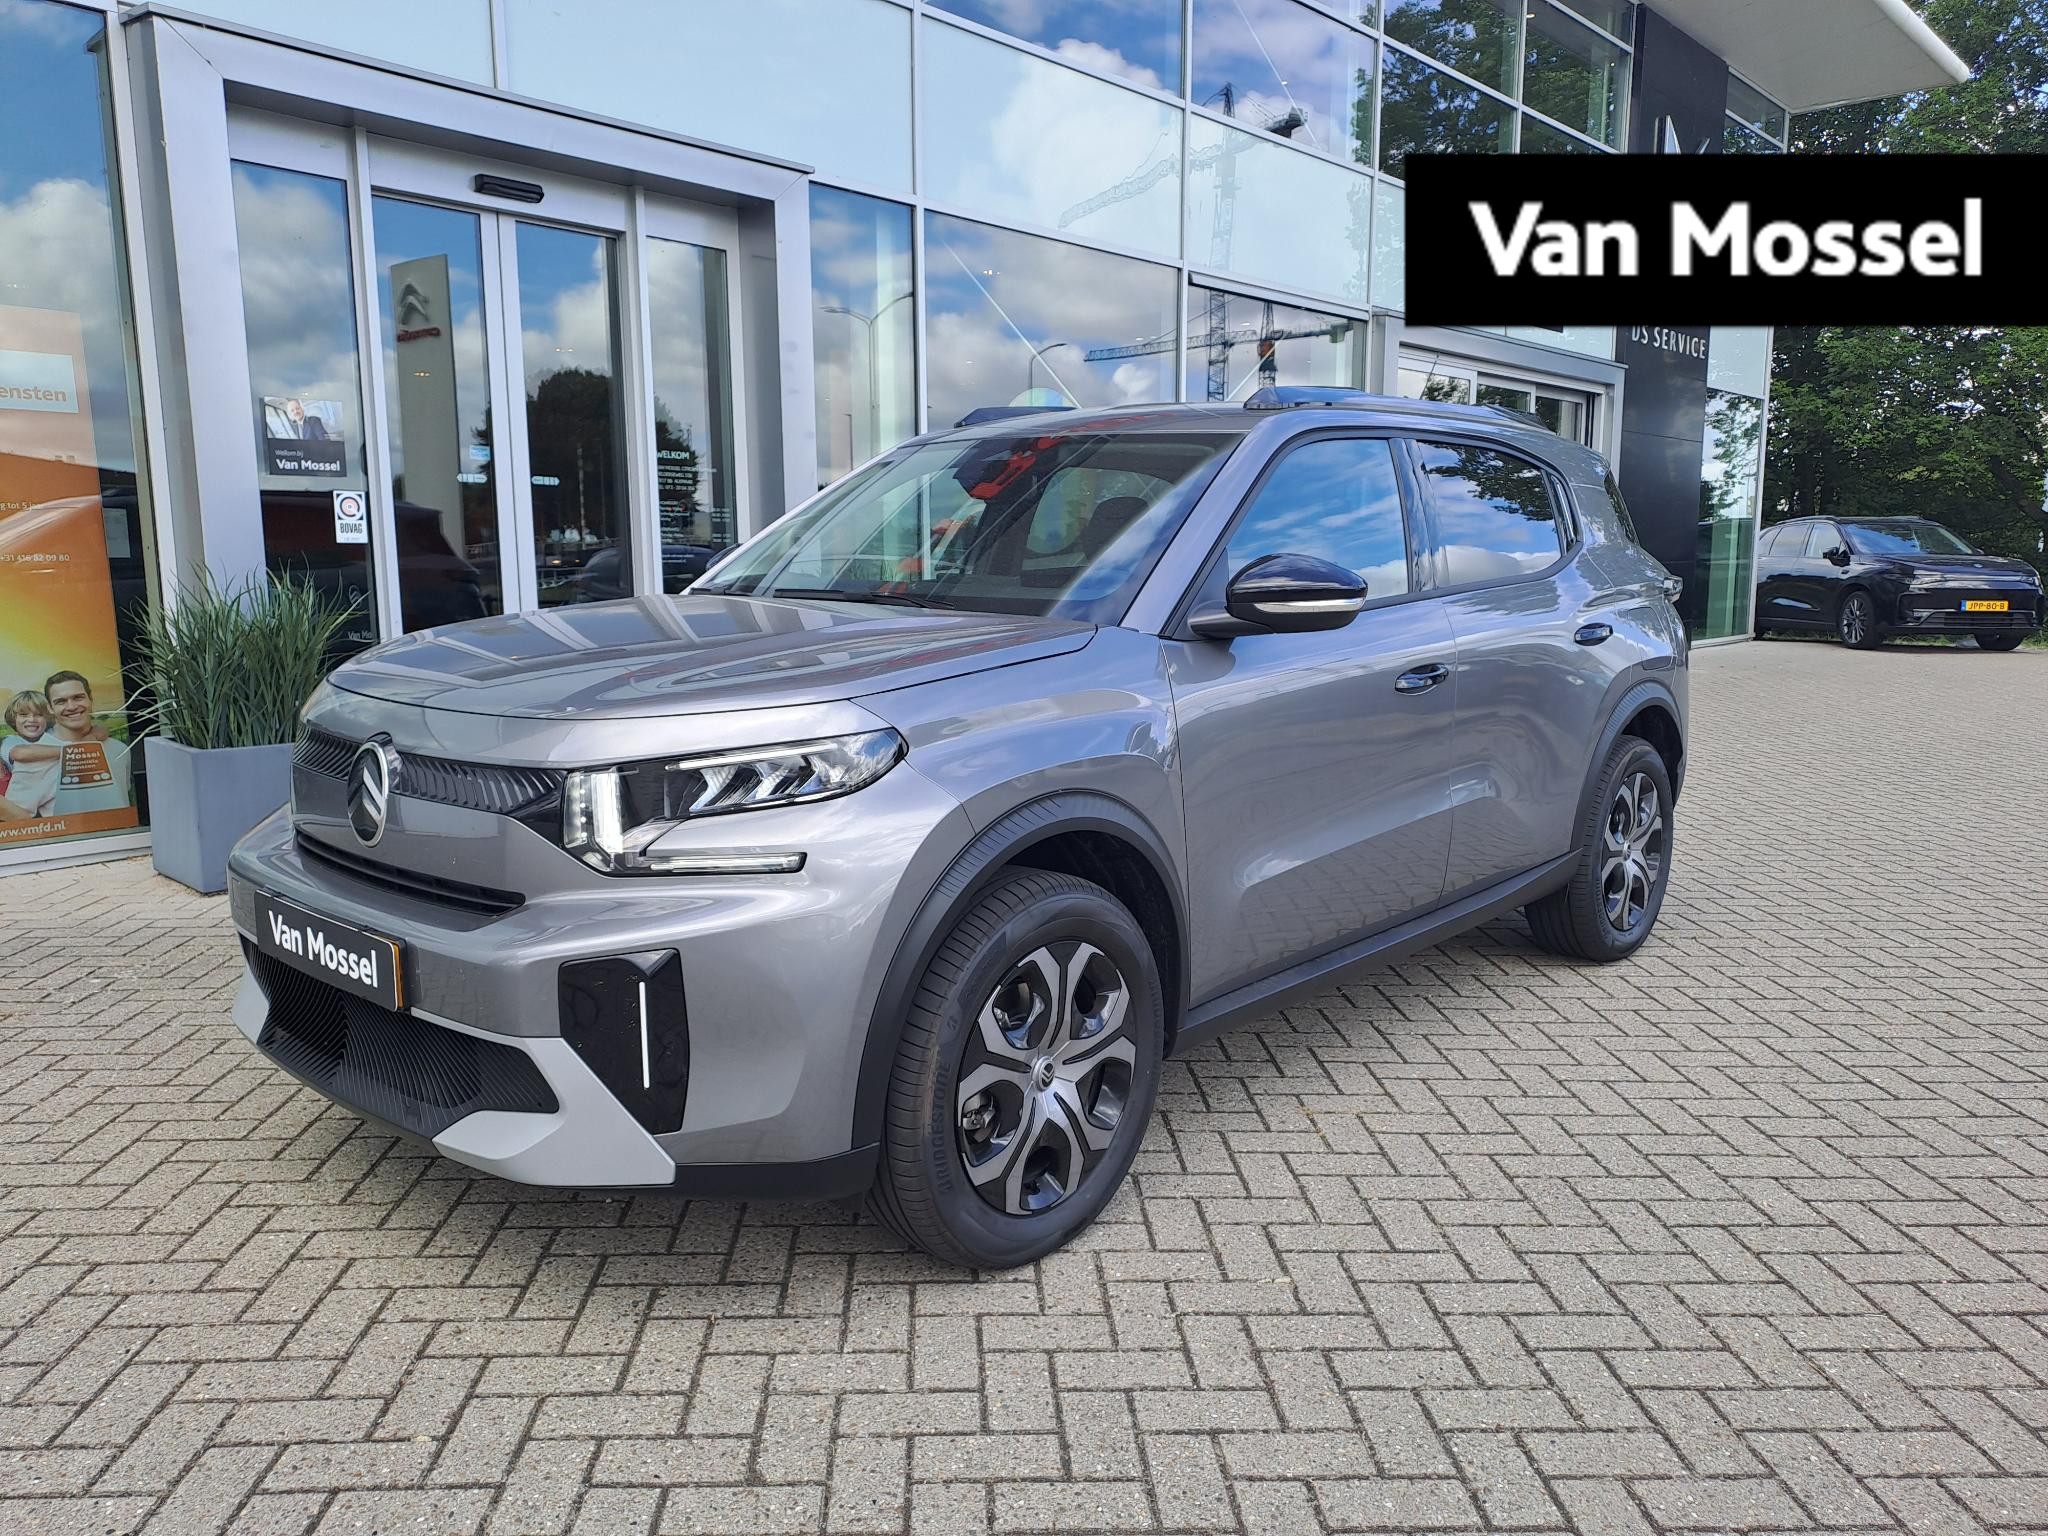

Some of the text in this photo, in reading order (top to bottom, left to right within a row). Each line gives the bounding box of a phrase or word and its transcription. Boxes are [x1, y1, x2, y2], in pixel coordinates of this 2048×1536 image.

[1631, 326, 1706, 359] DS SERVICE
[275, 459, 340, 472] Van Mossel
[340, 522, 363, 534] BOVAG
[1968, 602, 2005, 610] JPP-80-B
[268, 910, 378, 989] Van Mossel
[930, 1060, 953, 1193] BRIDGESTONE
